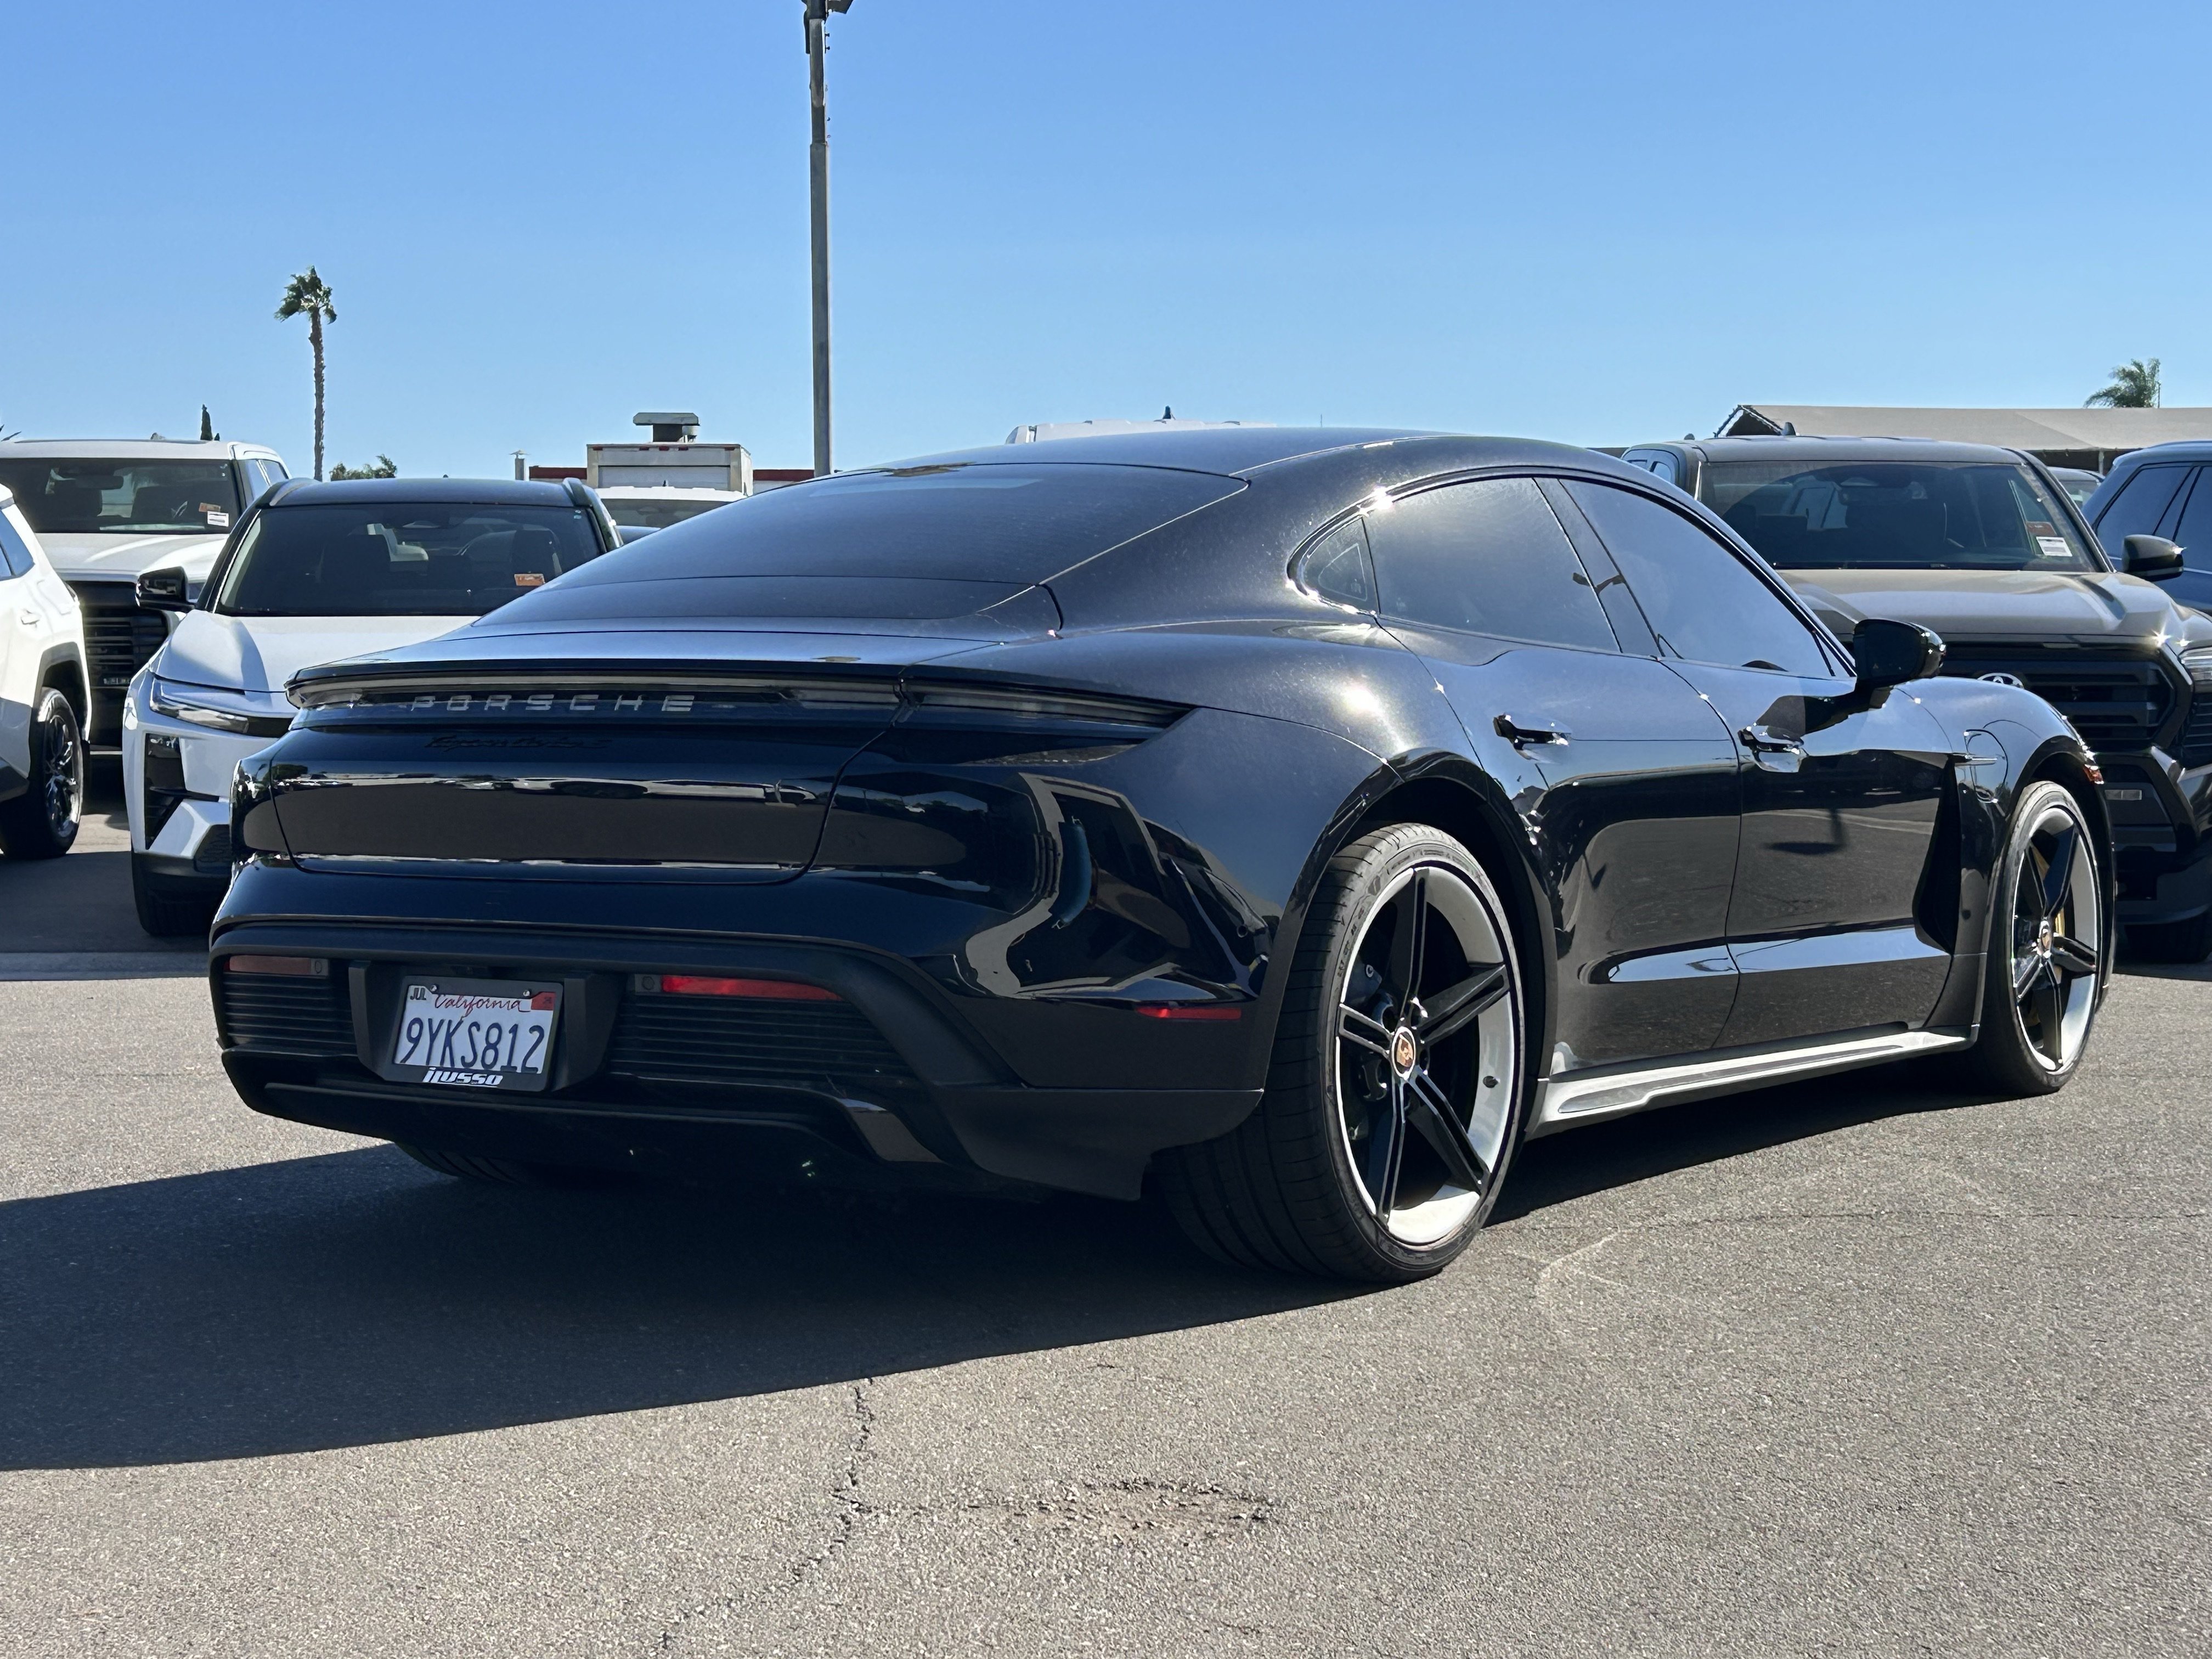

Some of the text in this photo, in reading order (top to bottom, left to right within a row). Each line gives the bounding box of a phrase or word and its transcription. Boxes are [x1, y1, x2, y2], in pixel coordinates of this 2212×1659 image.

[410, 694, 695, 712] PORSCHE
[435, 994, 531, 1019] California
[400, 1017, 544, 1074] 9YKS812
